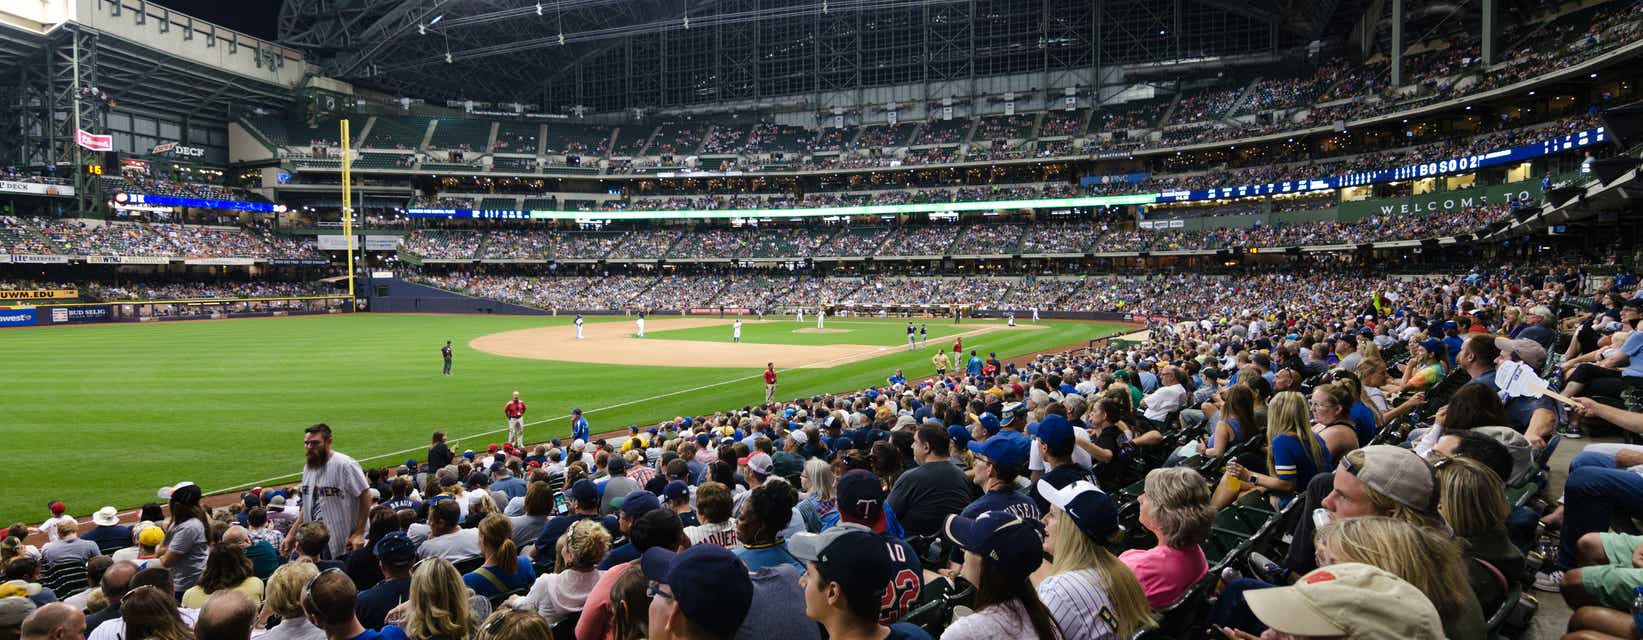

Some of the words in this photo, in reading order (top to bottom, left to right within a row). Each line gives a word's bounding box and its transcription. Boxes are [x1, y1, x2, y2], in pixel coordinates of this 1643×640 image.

[175, 145, 204, 157] DECK
[7, 183, 28, 191] DECK
[1503, 190, 1530, 203] TO
[0, 291, 54, 299] UWM.EDU
[390, 500, 413, 509] BRAUN
[856, 499, 878, 519] T
[699, 529, 737, 547] AUER
[879, 568, 921, 626] 22
